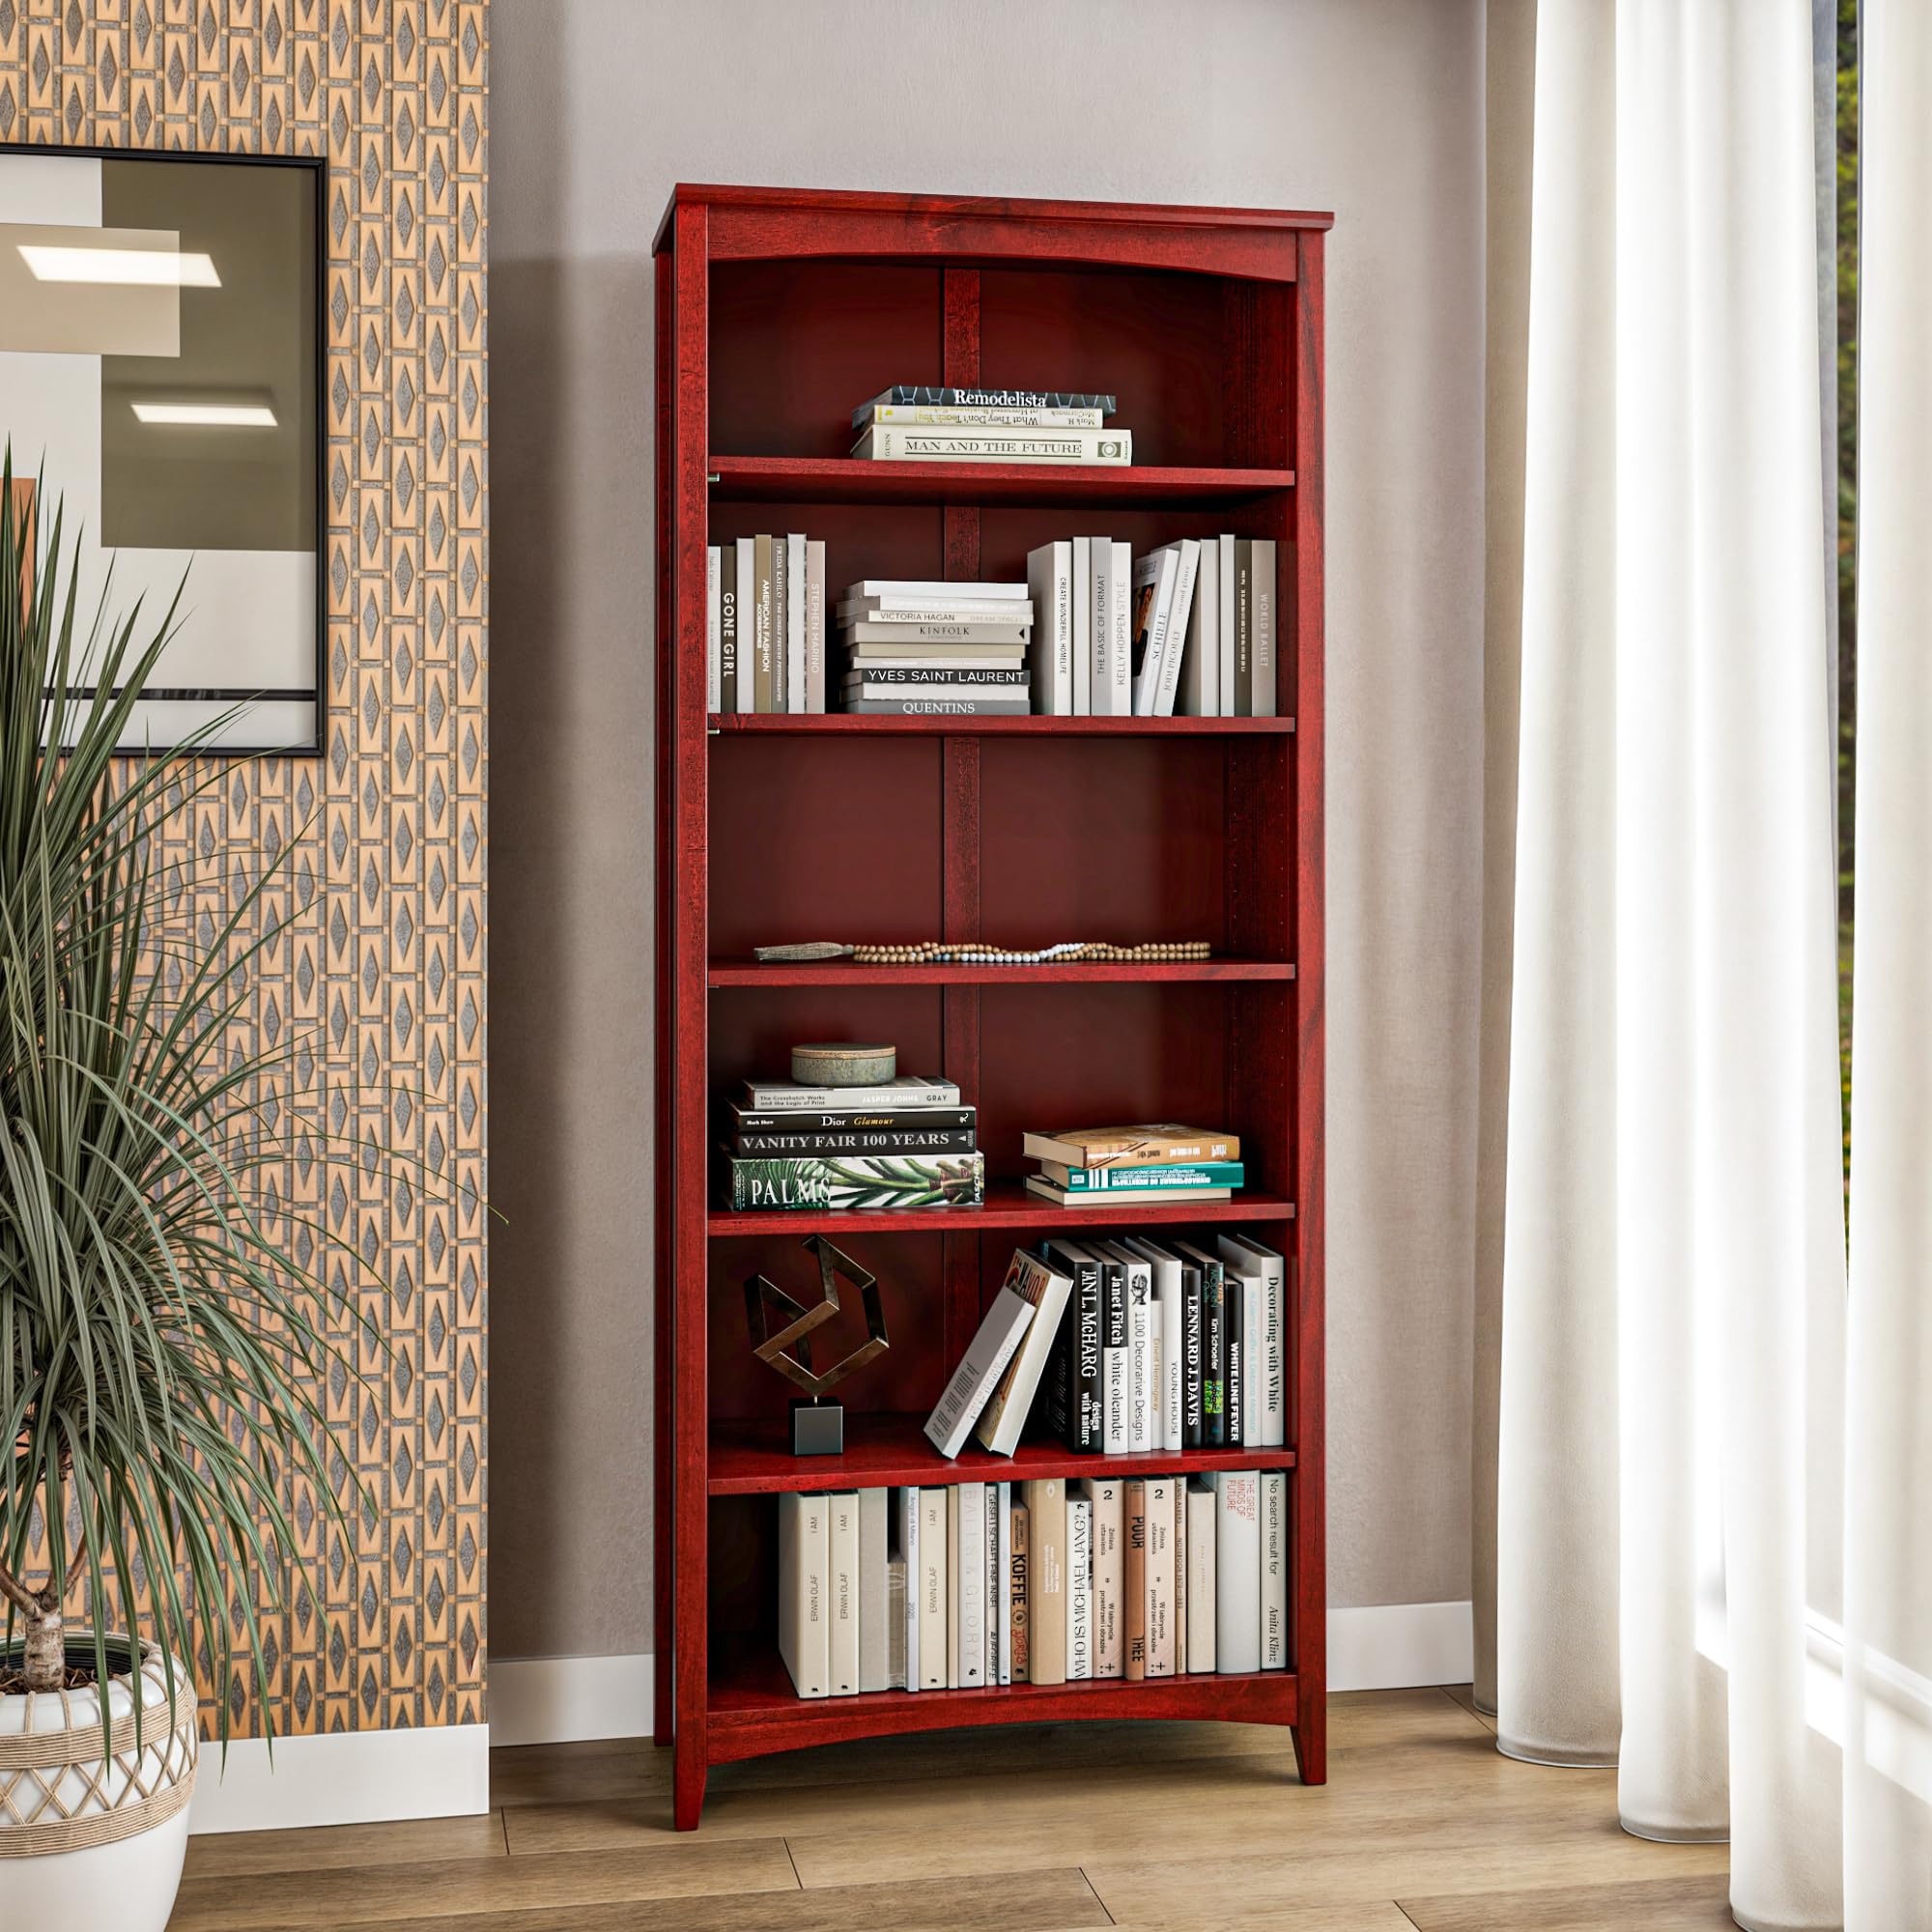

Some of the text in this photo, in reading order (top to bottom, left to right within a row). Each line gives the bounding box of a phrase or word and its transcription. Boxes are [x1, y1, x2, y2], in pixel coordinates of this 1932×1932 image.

[954, 389, 1047, 408] Remodelista
[938, 415, 961, 424] Teach
[964, 415, 986, 424] Don't
[988, 414, 1011, 425] They
[905, 440, 1082, 454] MAN AND THE FUTURE
[1116, 582, 1125, 611] STYLE
[881, 612, 922, 621] VICTORIA
[1097, 616, 1105, 627] OF
[1260, 594, 1268, 667] WORLD BALLET
[724, 593, 734, 678] GONE GIRL
[920, 626, 970, 636] KINFOLK
[1117, 613, 1125, 655] HOPPEN
[1152, 611, 1167, 660] SCHIELE
[811, 633, 820, 673] MARINO
[868, 670, 1024, 682] YVES SAINT LAURENT
[902, 703, 976, 714] QUENTINS
[821, 1117, 895, 1126] Dior Glamour
[742, 1134, 950, 1150] VANITY FAIR 100 YEARS
[752, 1178, 831, 1206] PALMS
[1082, 1270, 1096, 1378] JAN L. McHARG
[1111, 1277, 1123, 1345] Janet Fitch
[1135, 1312, 1145, 1337] 1100
[1265, 1277, 1279, 1412] Decorating with White
[1188, 1295, 1198, 1426] LENNARD J. DAVIS
[1112, 1352, 1122, 1441] white oleander
[1151, 1364, 1160, 1411] Hemingway
[1082, 1391, 1092, 1445] with nature
[1090, 1401, 1101, 1431] design
[1132, 1400, 1146, 1441] Designs
[1103, 1490, 1113, 1500] 2
[1155, 1490, 1164, 1499] 2
[1227, 1479, 1236, 1511] FUTURE
[1246, 1495, 1255, 1520] GREAT
[810, 1517, 818, 1528] AM
[840, 1515, 848, 1526] AM
[929, 1509, 937, 1521] AM
[1237, 1506, 1245, 1517] OF
[1132, 1516, 1144, 1548] PUUR
[1269, 1479, 1278, 1575] No search result for
[1012, 1554, 1026, 1606] KOFFIE
[1074, 1515, 1086, 1678] WHO IS MICHAEL JANG?
[966, 1585, 980, 1659] GLORY
[1269, 1605, 1279, 1662] Anita Klinz
[1132, 1634, 1144, 1662] THEE
